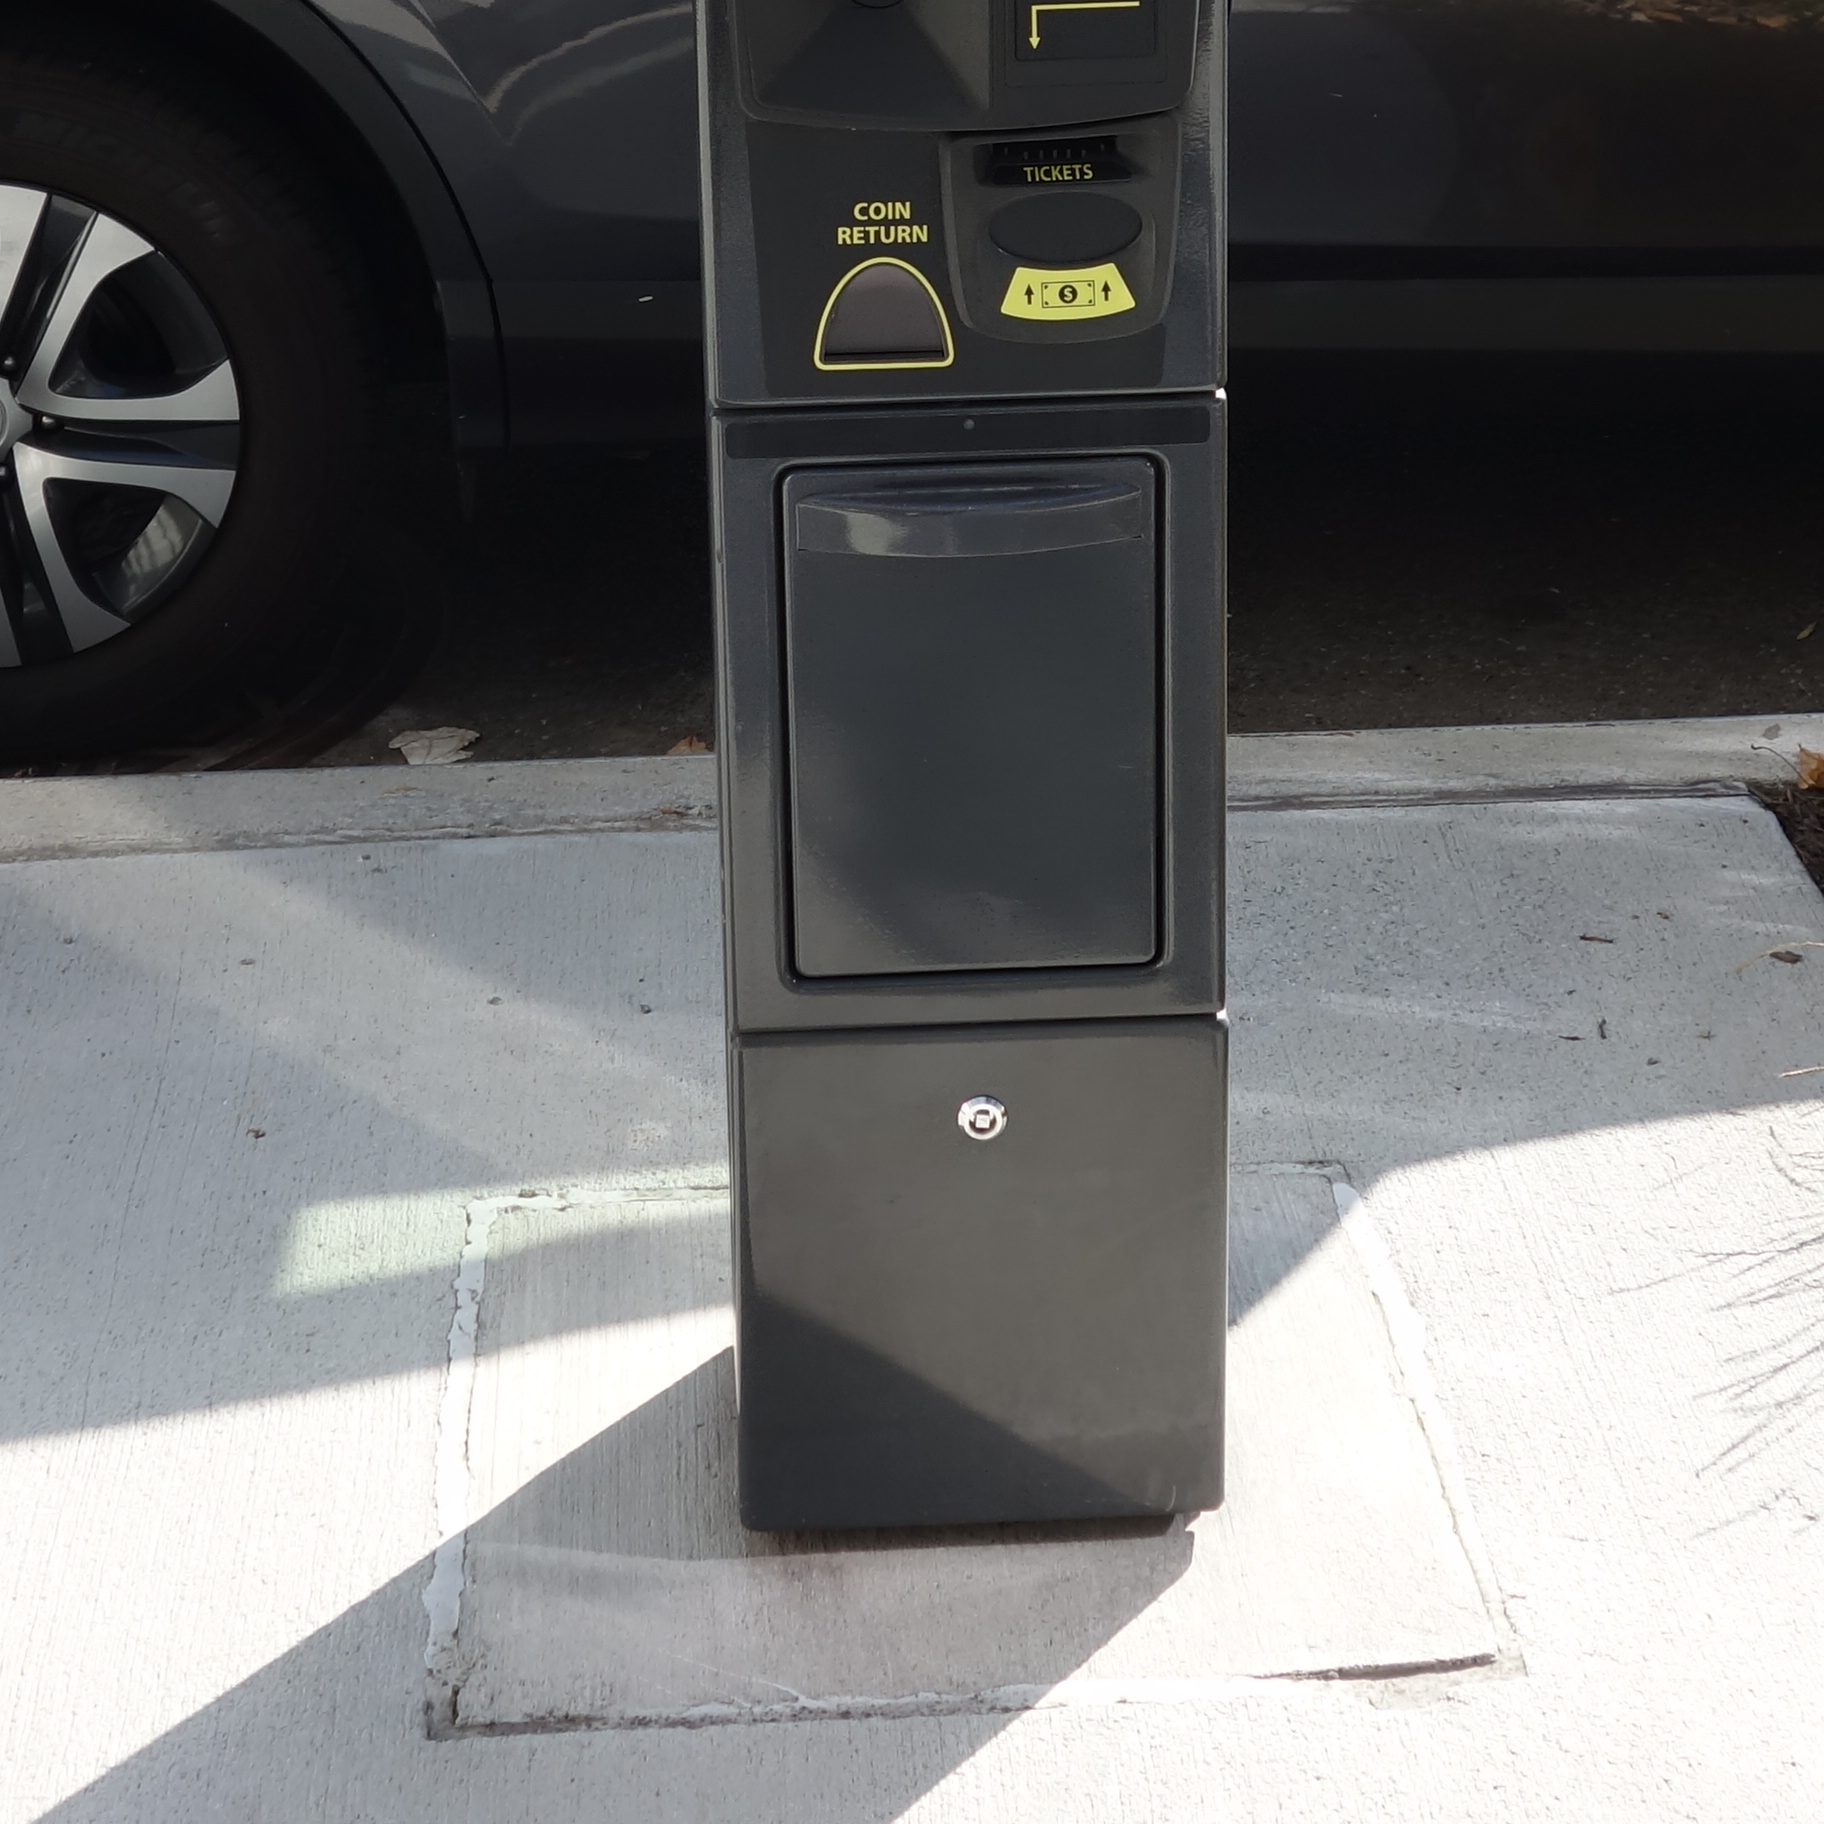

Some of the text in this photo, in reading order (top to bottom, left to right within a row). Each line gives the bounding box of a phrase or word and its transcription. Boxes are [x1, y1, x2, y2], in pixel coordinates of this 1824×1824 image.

[1023, 163, 1094, 183] TICKETS
[853, 201, 911, 221] COIN
[837, 224, 928, 245] RETURN
